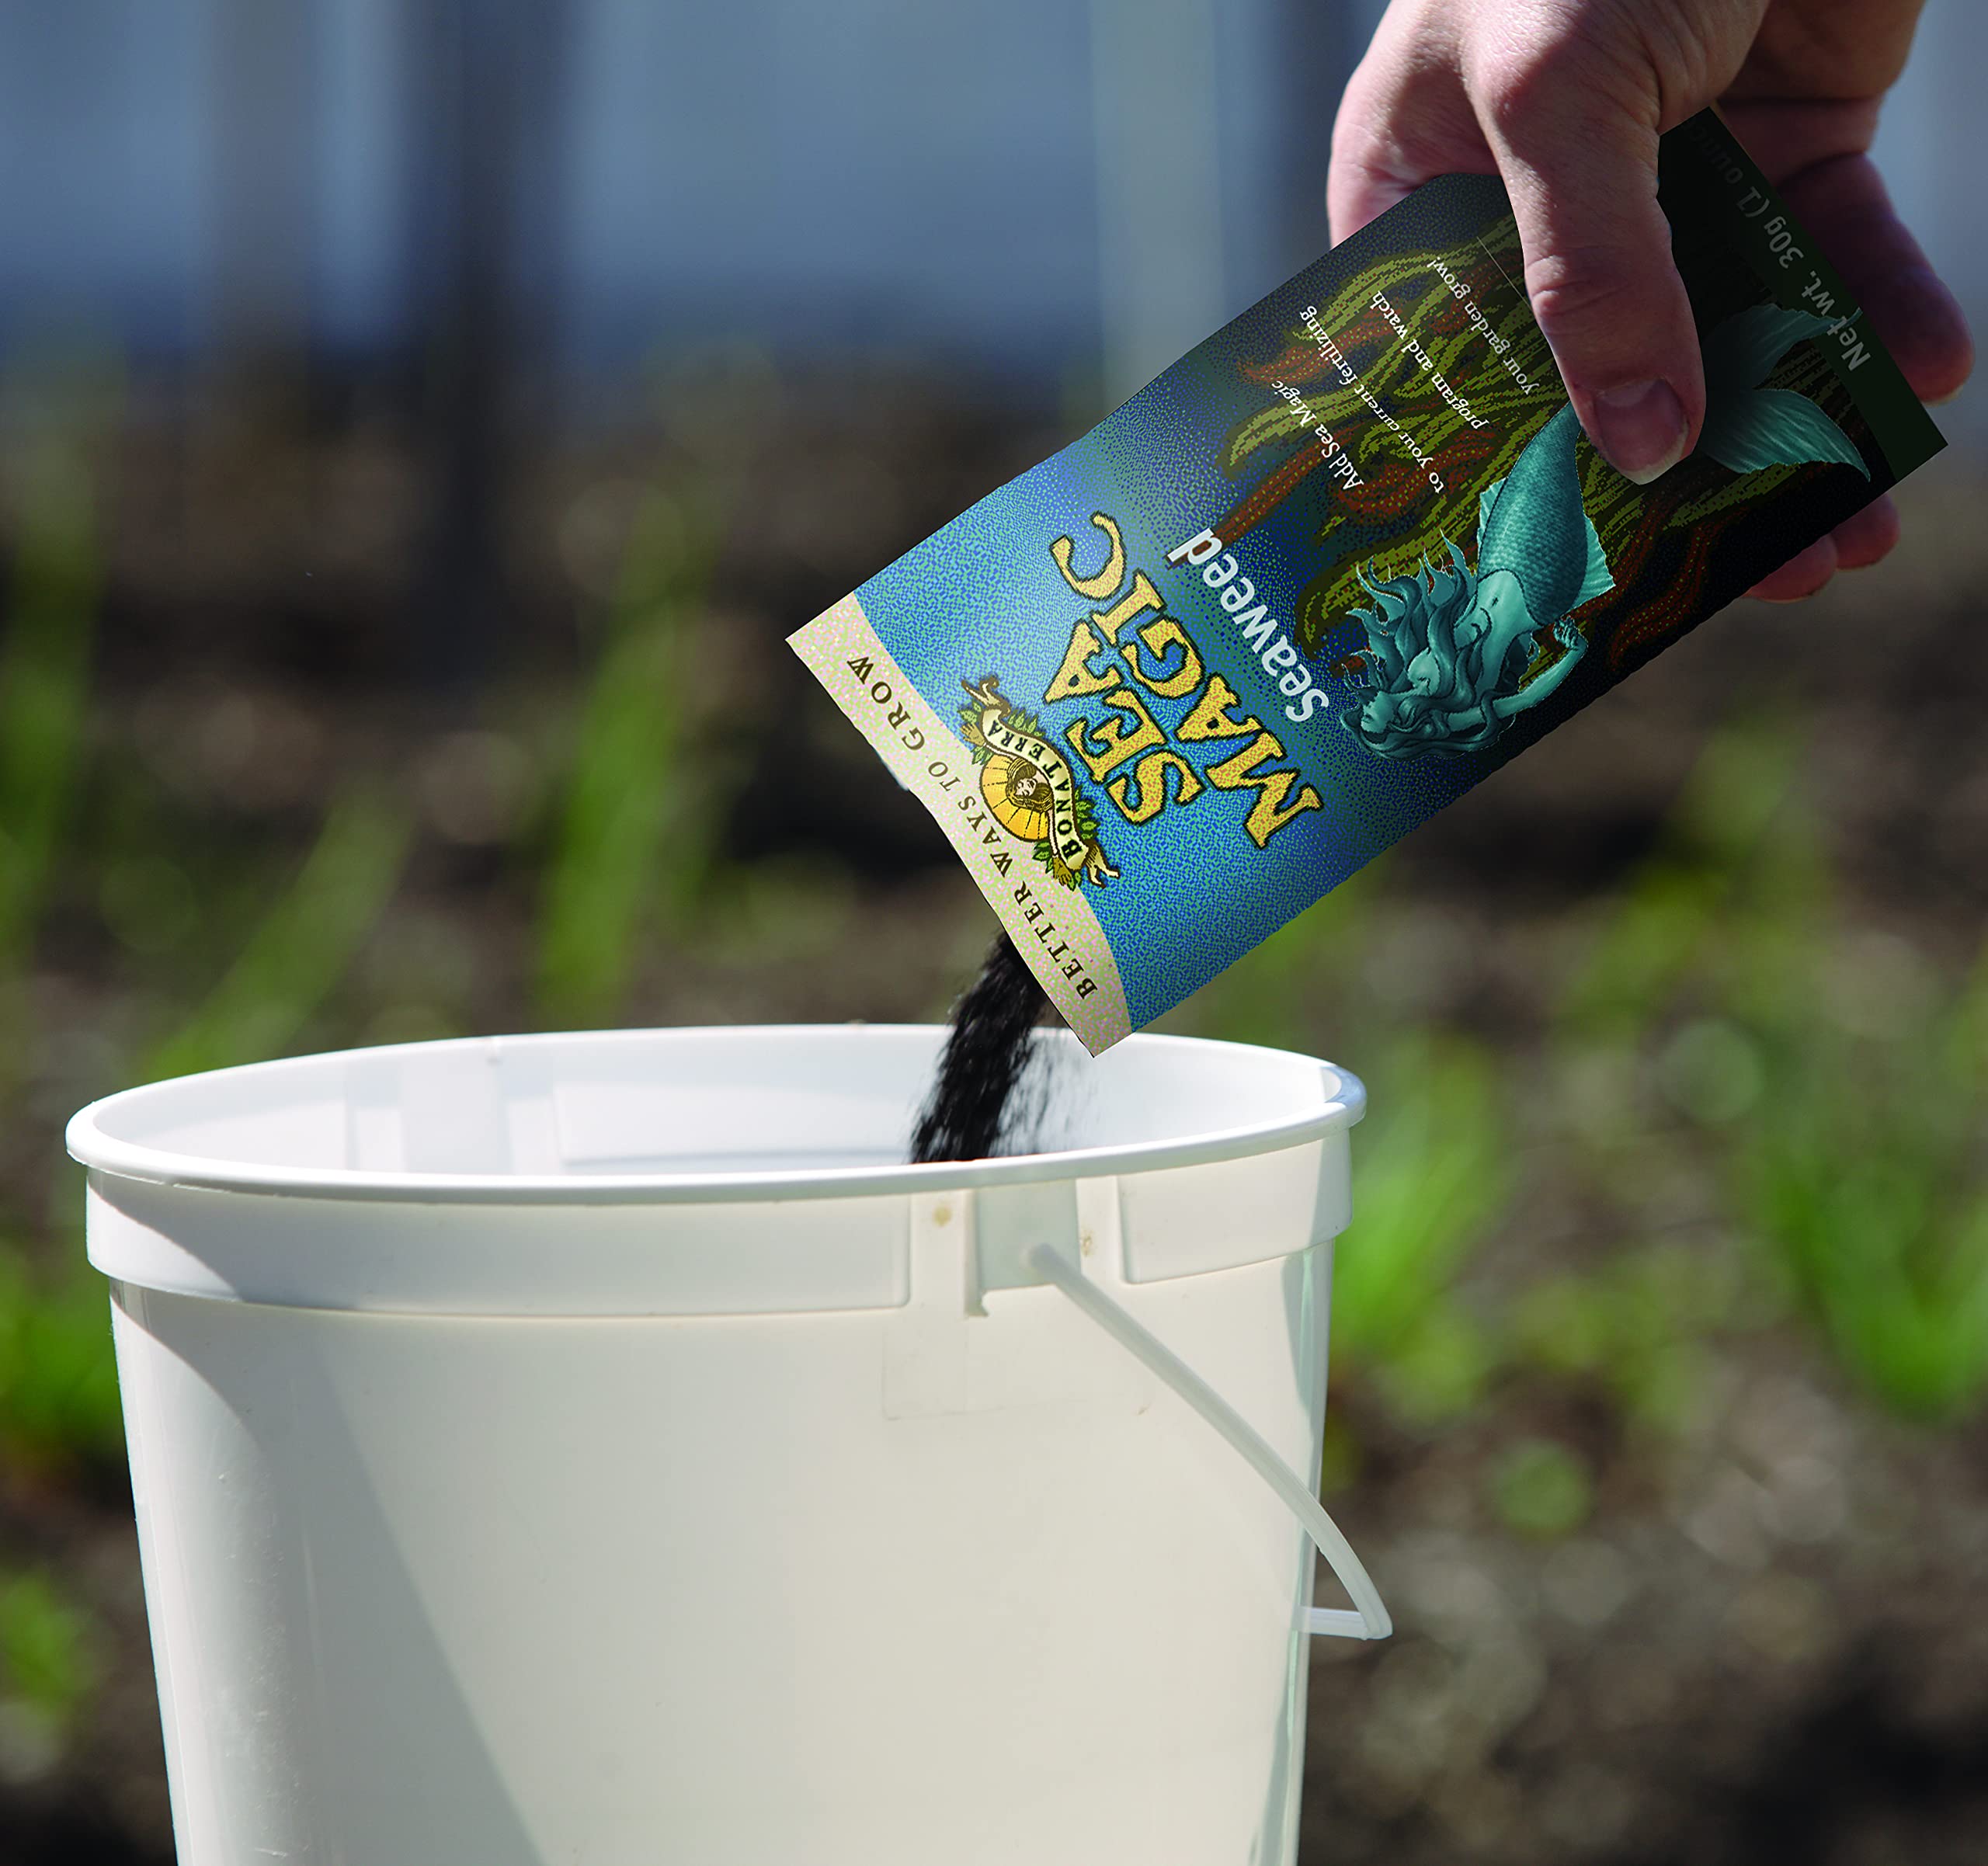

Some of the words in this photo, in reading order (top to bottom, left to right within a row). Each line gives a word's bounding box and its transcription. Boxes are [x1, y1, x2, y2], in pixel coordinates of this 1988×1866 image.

[1736, 186, 1771, 217] (1
[1764, 217, 1804, 269] 30g
[1427, 256, 1471, 300] grow!
[1801, 269, 1836, 316] wt.
[1370, 290, 1409, 339] watch
[1465, 301, 1512, 356] garden
[1299, 305, 1360, 385] fertilizing
[1401, 339, 1434, 371] and
[1826, 316, 1871, 372] Net
[1503, 357, 1539, 395] your
[1271, 380, 1317, 426] Magic
[1354, 384, 1399, 432] current
[1431, 373, 1489, 429] program
[1312, 425, 1340, 459] Sea
[1398, 432, 1434, 468] your
[1329, 453, 1364, 491] Add
[1429, 472, 1444, 494] to
[1167, 528, 1329, 722] Seaweed
[847, 655, 925, 752] GROW
[1050, 511, 1323, 850] MAGIC
[1043, 619, 1206, 825] SEA
[928, 759, 961, 791] TO
[958, 797, 1013, 878] WAYS
[1013, 880, 1097, 999] BETTER
